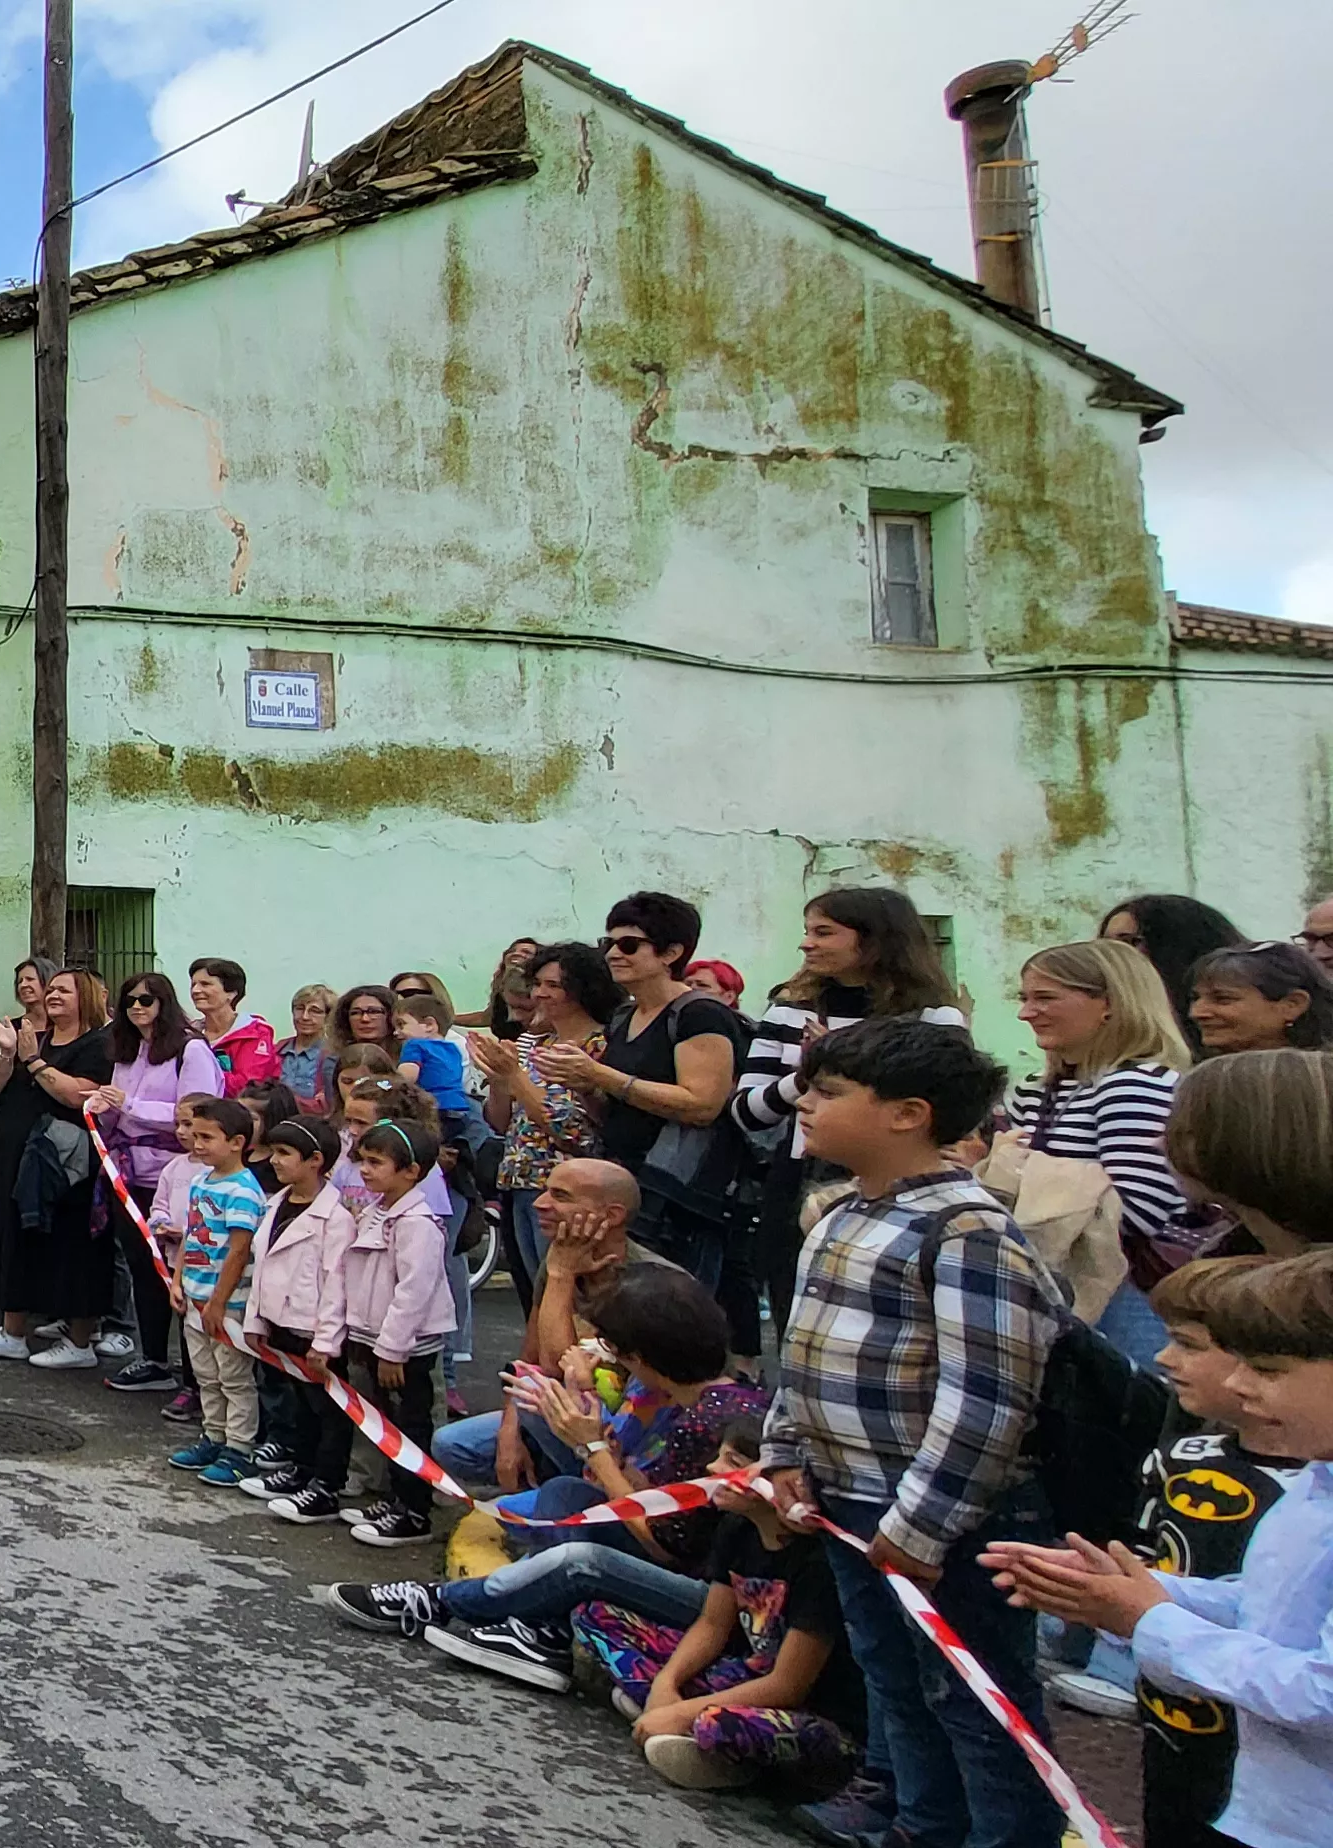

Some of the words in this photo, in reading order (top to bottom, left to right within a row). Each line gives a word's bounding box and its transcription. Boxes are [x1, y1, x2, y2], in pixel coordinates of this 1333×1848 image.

[274, 682, 309, 697] Calle
[252, 699, 285, 717] Manuel
[287, 701, 315, 719] Planas
